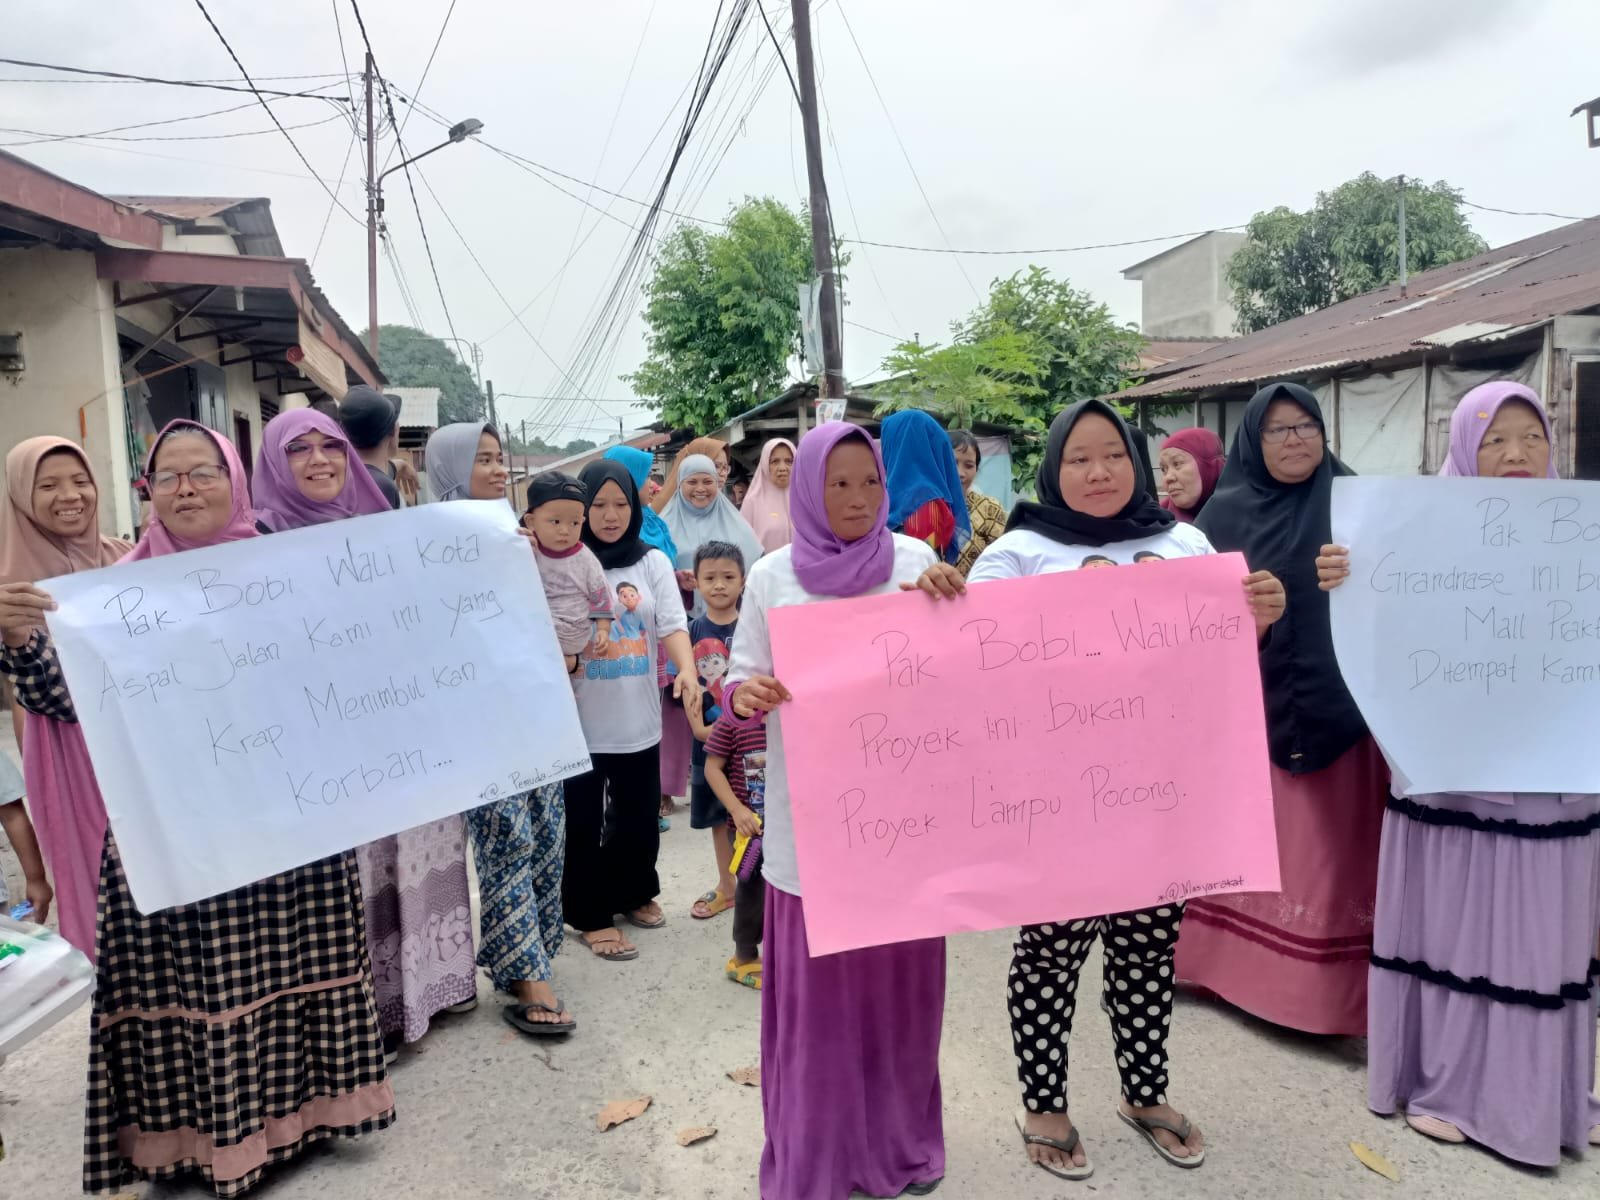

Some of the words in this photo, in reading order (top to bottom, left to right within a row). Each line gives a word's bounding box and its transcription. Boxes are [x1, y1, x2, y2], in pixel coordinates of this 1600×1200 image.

[1476, 497, 1521, 547] Pak
[184, 569, 293, 615] Bobi
[326, 538, 395, 586] Wali
[416, 534, 480, 568] Kota
[1465, 605, 1525, 641] Mall
[100, 661, 181, 711] Aspal
[193, 636, 280, 692] Jalan
[302, 616, 372, 652] Kami
[392, 605, 421, 632] ini
[871, 630, 939, 687] Pak
[205, 718, 284, 766] Krap
[849, 712, 964, 775] Proyek
[983, 715, 1017, 741] ini
[837, 787, 939, 857] Proyek
[971, 776, 1062, 846] Lampu
